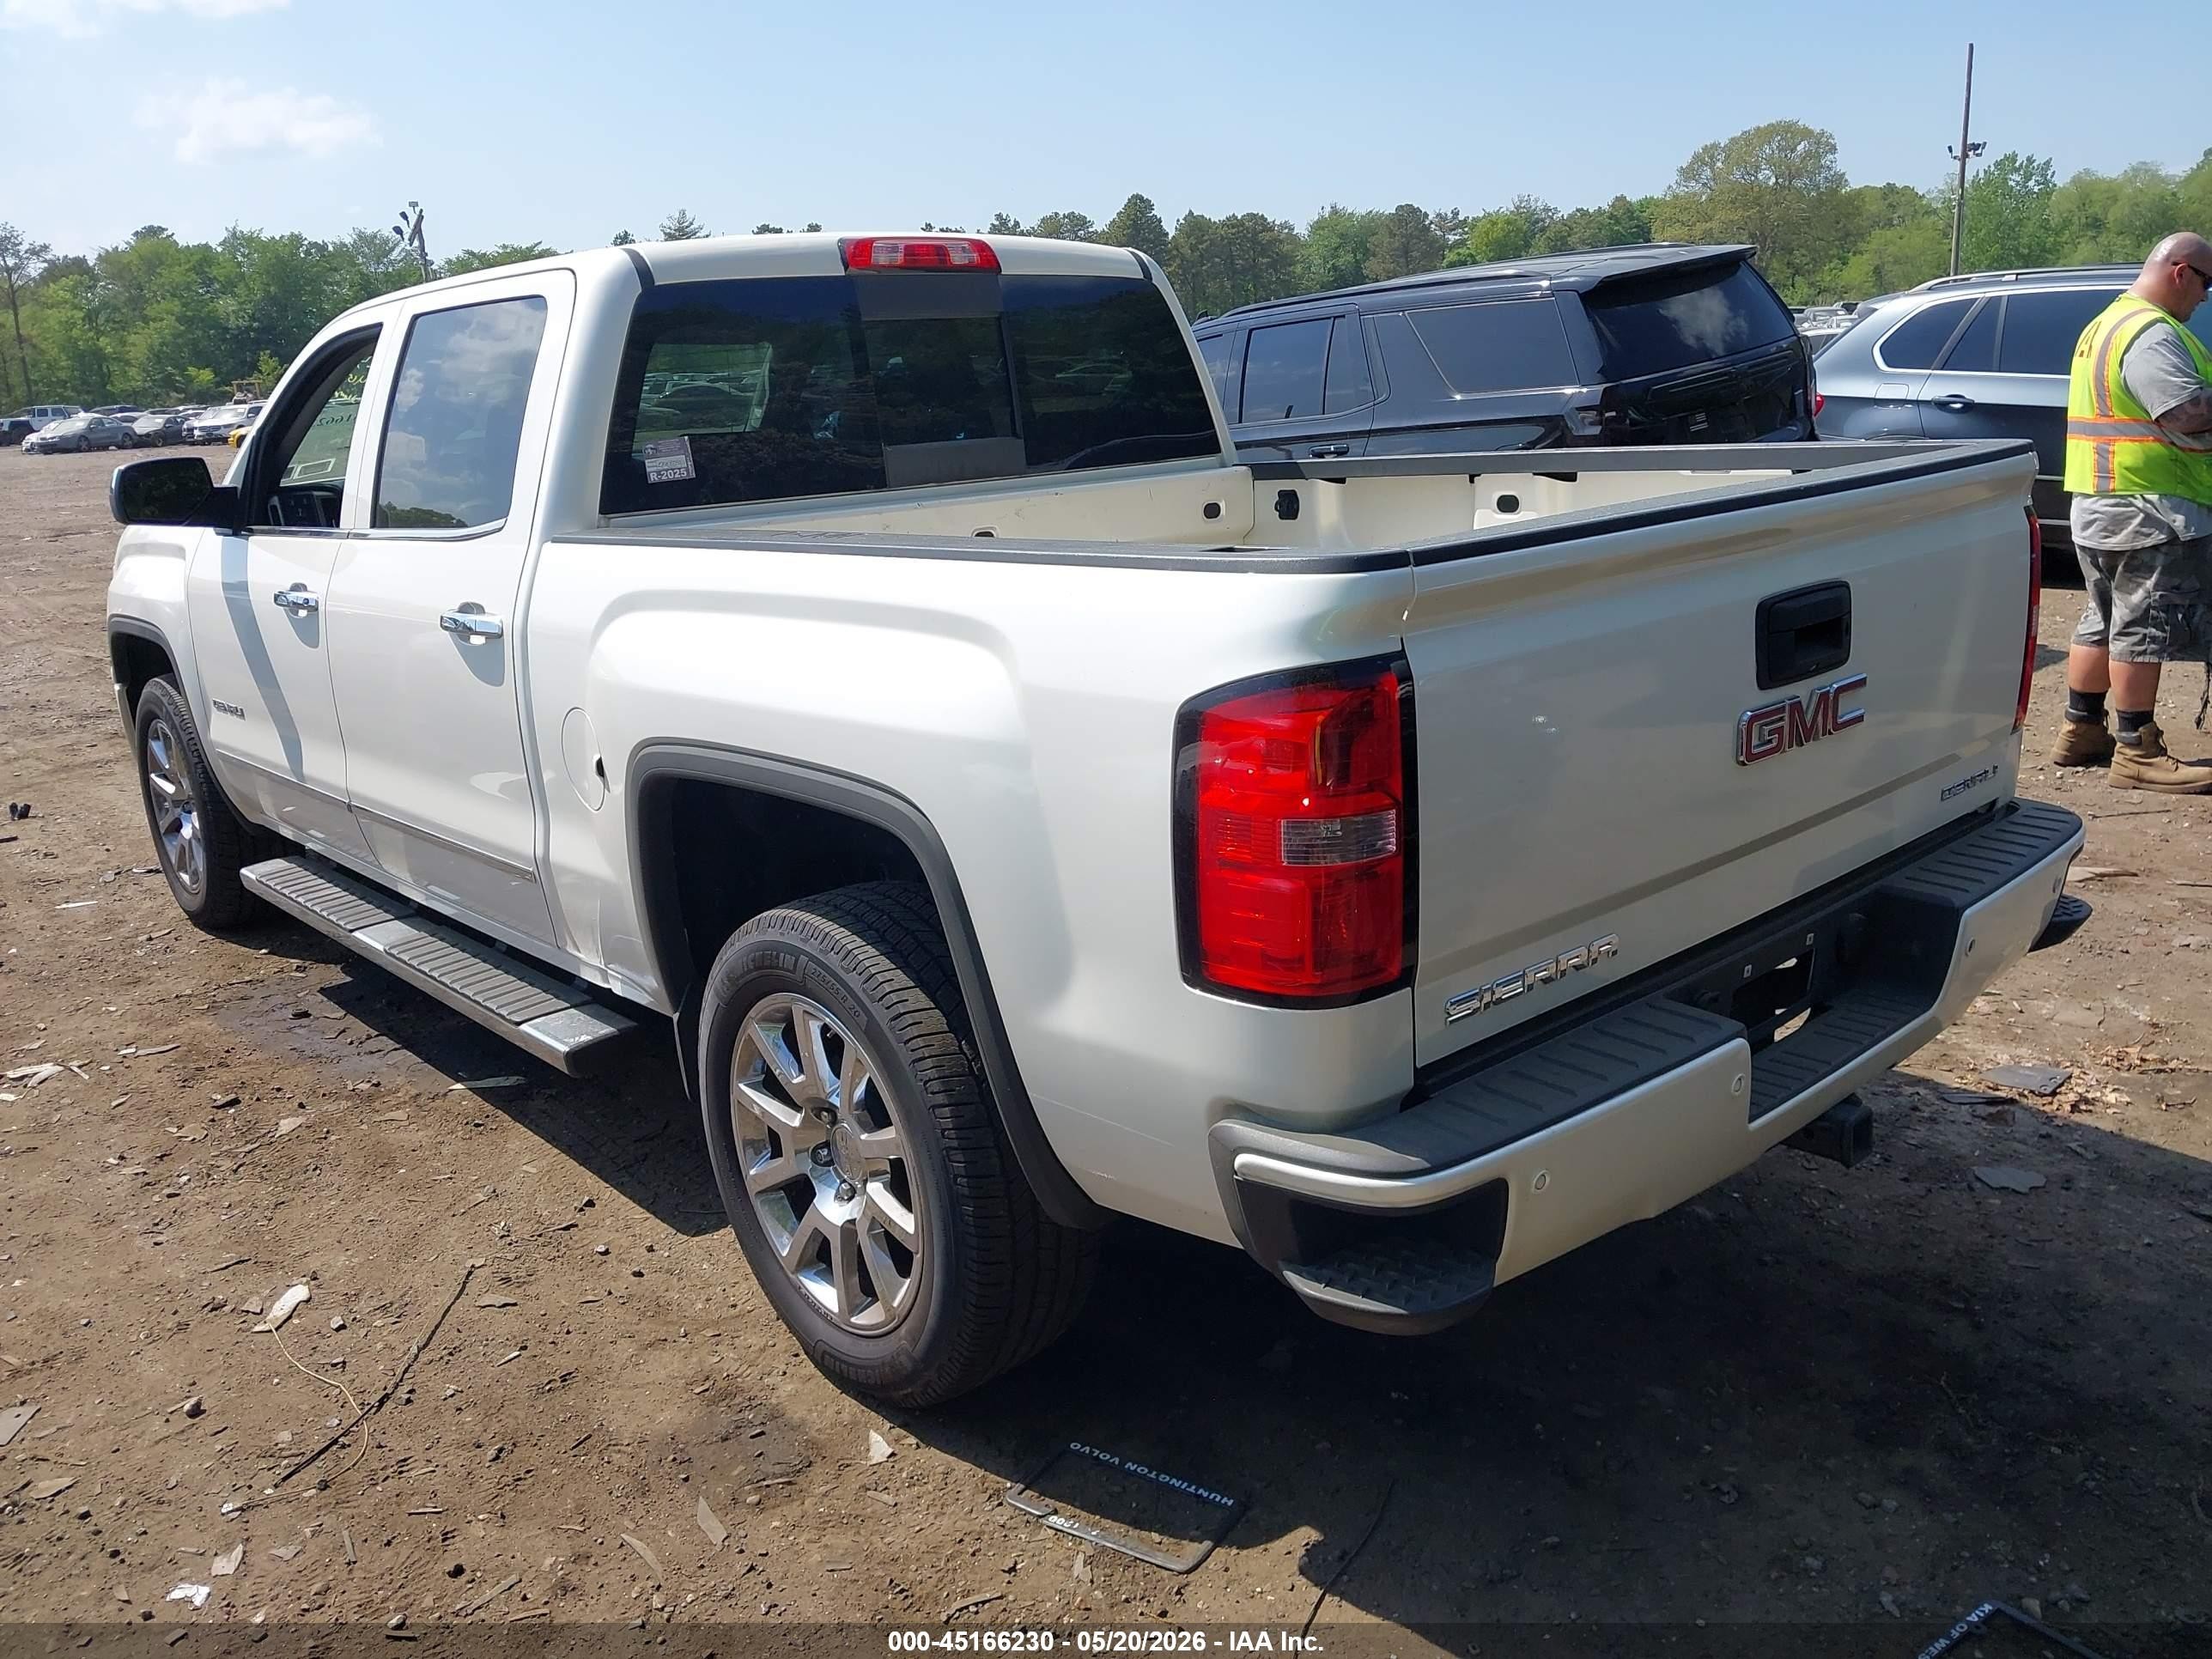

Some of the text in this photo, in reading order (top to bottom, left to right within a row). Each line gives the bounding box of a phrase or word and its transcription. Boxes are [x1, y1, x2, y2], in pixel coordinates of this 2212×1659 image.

[649, 468, 687, 482] R-2025
[1735, 672, 1868, 765] GMC
[1444, 933, 1621, 1025] SIERRA
[841, 994, 848, 1004] R
[848, 1004, 860, 1018] 20
[1069, 1441, 1235, 1507] HUNTINGTON VOLVO
[1966, 1602, 1993, 1622] KIA
[1950, 1623, 1968, 1639] OF
